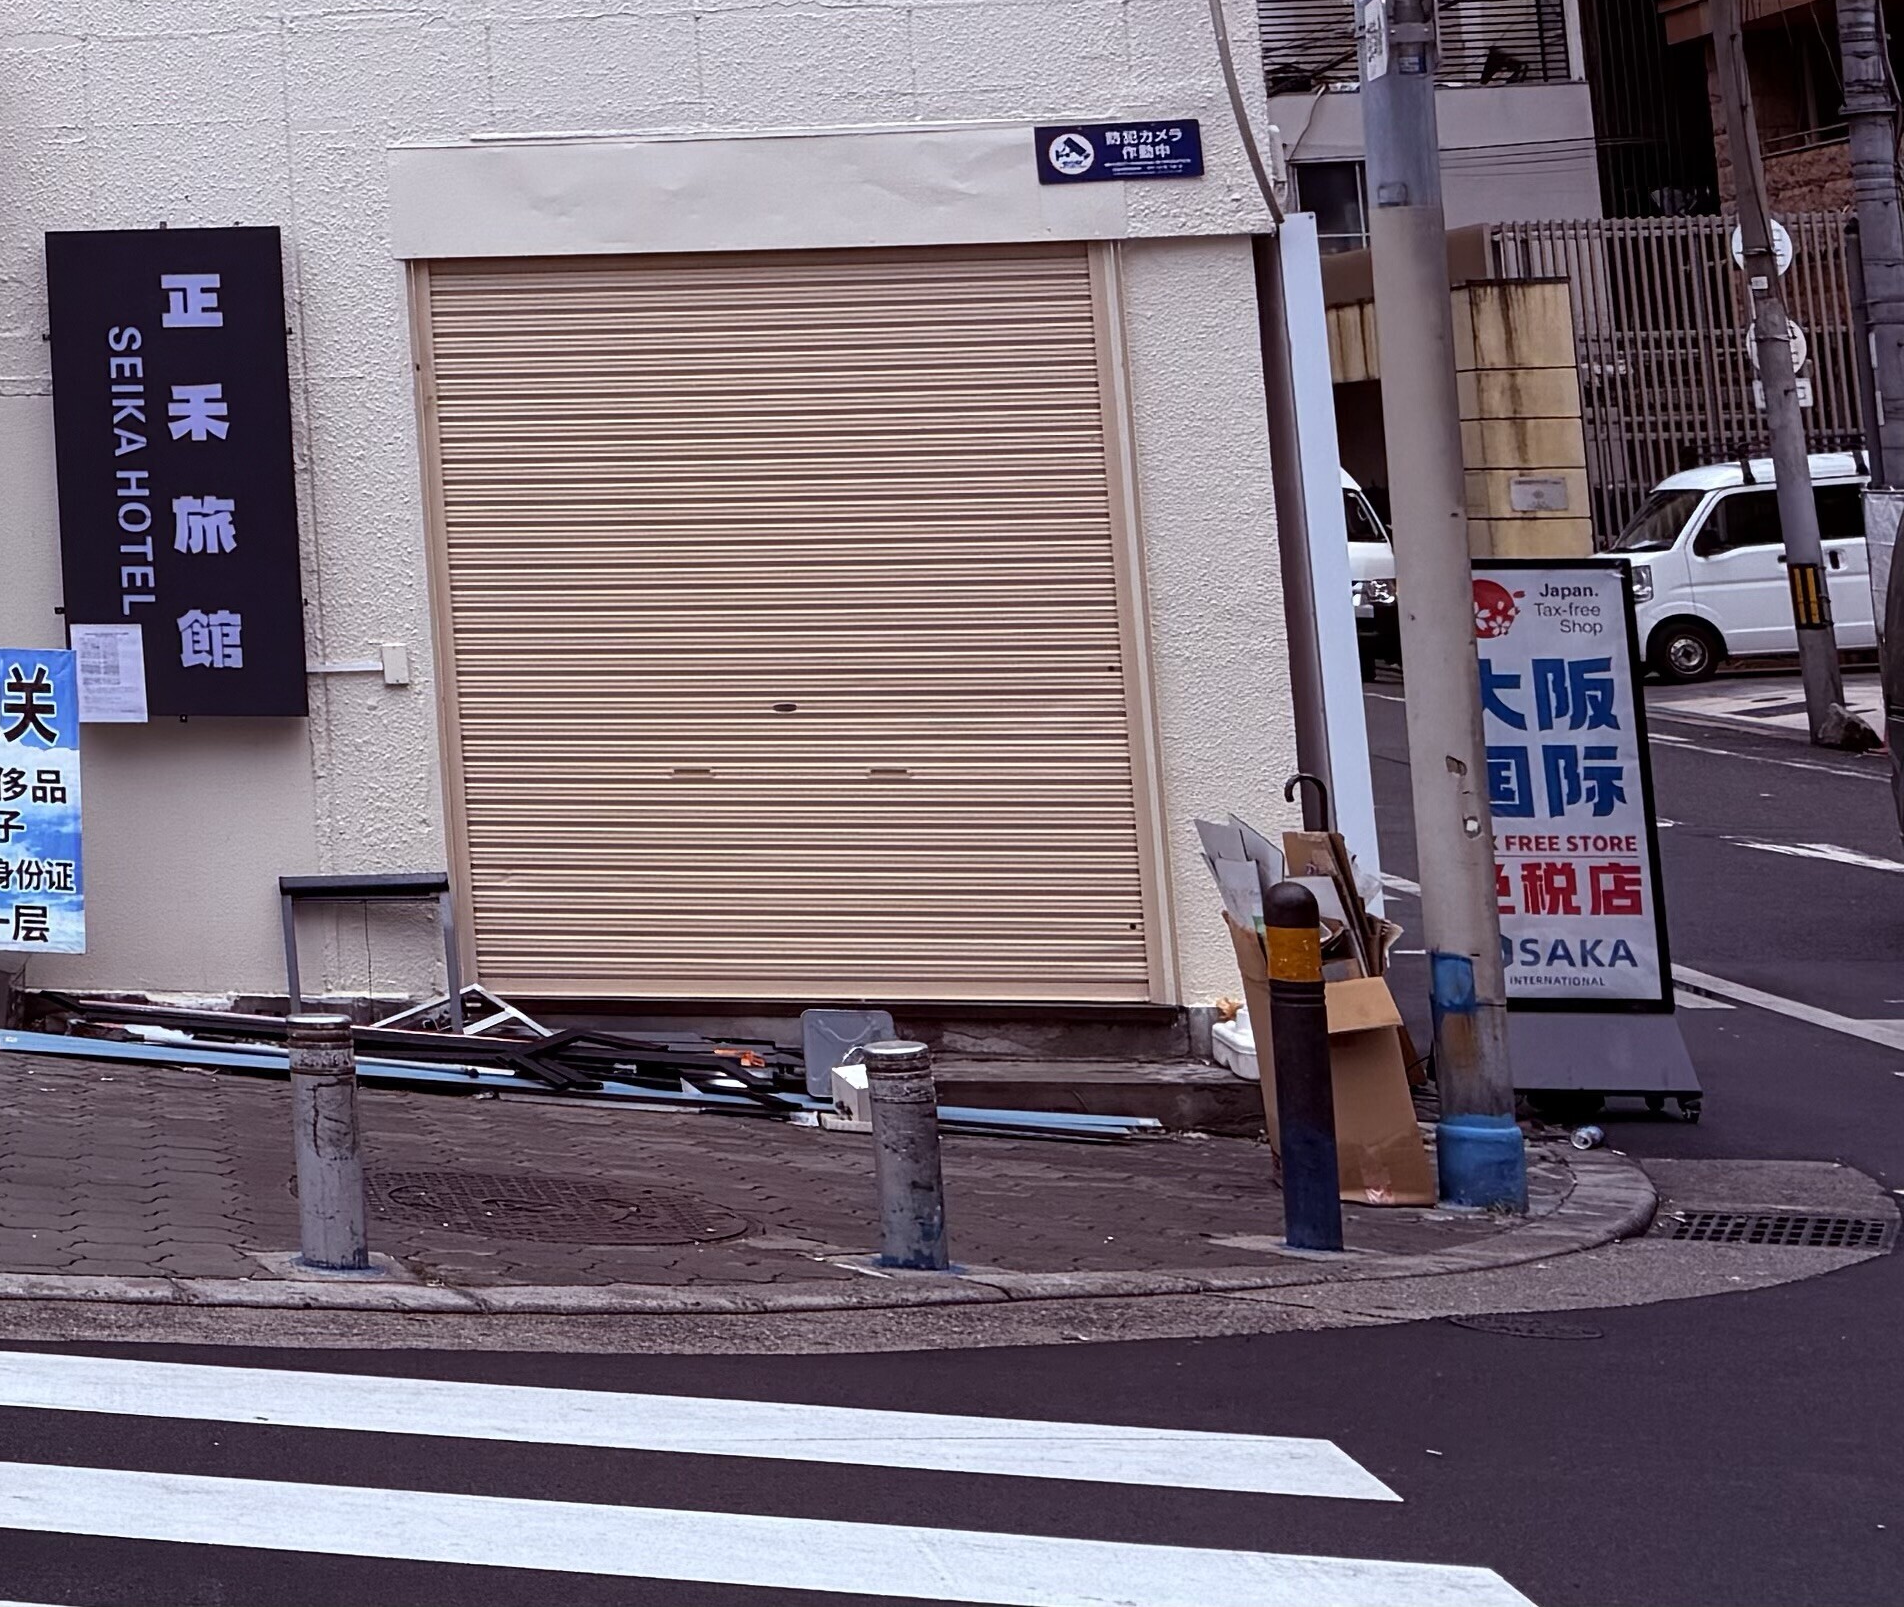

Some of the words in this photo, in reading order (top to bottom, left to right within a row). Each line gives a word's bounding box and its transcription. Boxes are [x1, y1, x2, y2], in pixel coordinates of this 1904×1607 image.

[1104, 128, 1183, 145] 防犯カメラ
[1122, 144, 1171, 160] 作動中
[108, 325, 149, 457] SEIKA
[115, 469, 156, 616] HOTEL
[1539, 583, 1599, 600] Japan.
[1534, 602, 1601, 617] Tax-free
[1560, 619, 1604, 636] Shop
[1505, 835, 1561, 852] FREE
[1566, 835, 1638, 852] STORE
[1509, 975, 1607, 987] INTERNATIONAL
